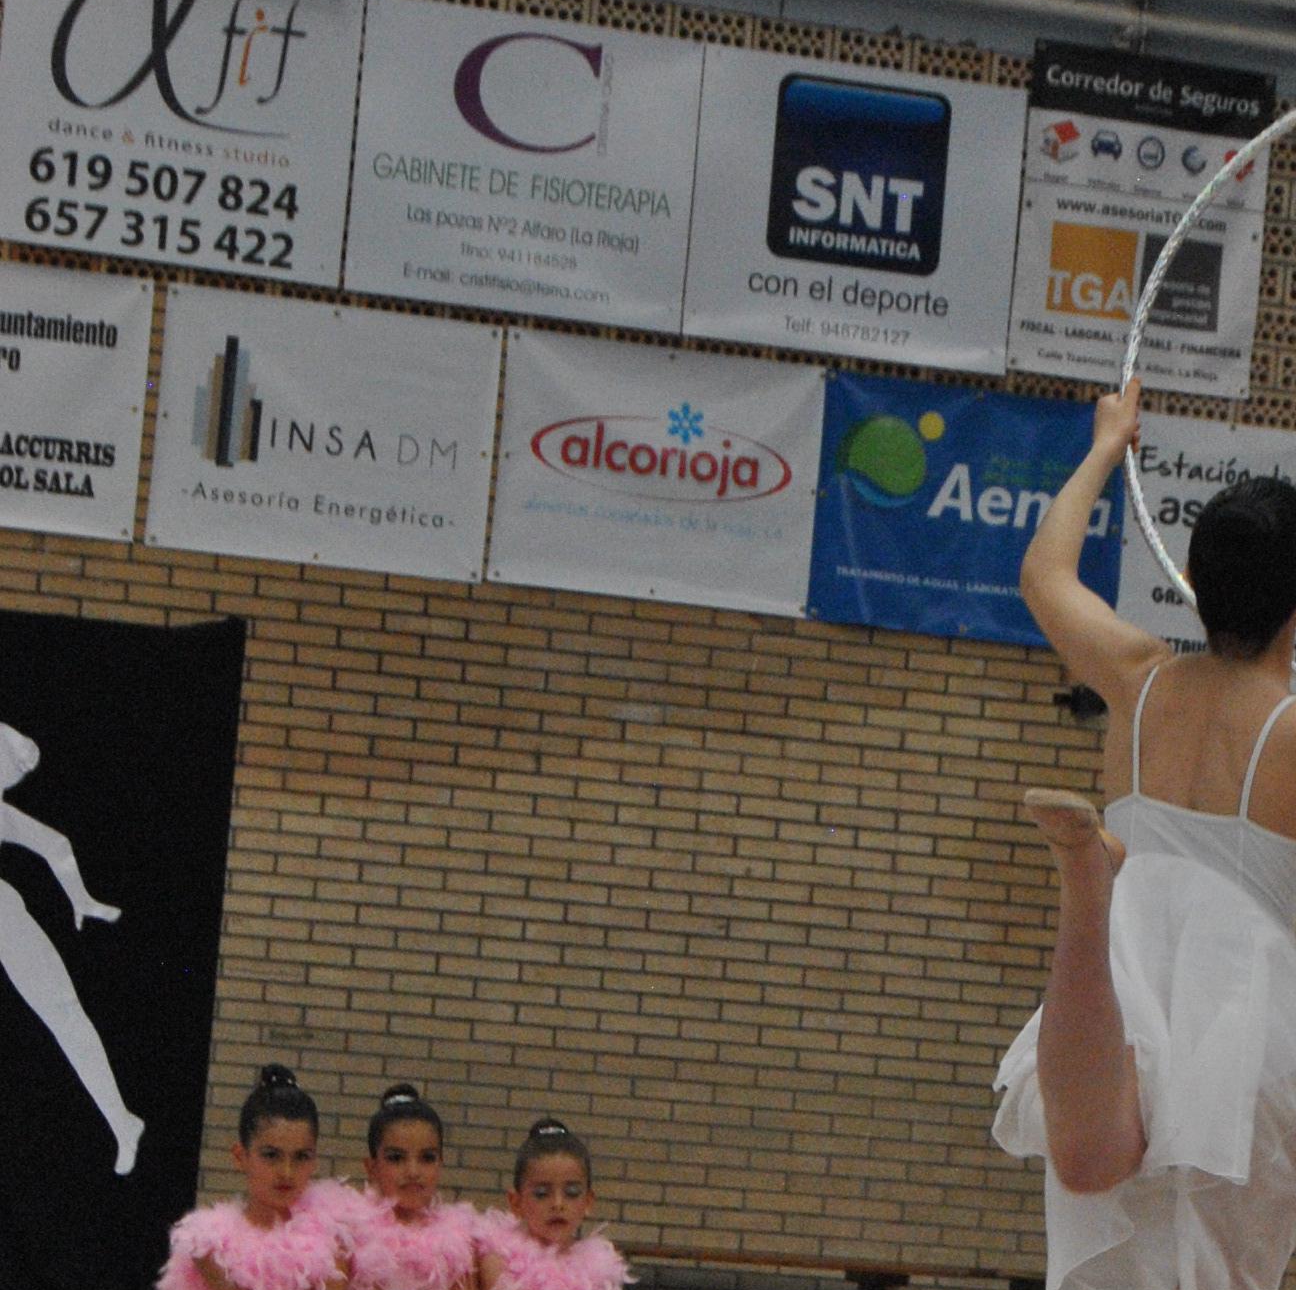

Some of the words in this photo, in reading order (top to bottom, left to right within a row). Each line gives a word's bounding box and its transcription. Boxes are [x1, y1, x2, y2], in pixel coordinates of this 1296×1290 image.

[454, 32, 602, 154] C
[1047, 63, 1144, 97] Corredor
[1150, 80, 1173, 102] de
[1180, 86, 1260, 117] Seguros
[48, 117, 113, 141] dance
[121, 130, 135, 144] &
[145, 132, 213, 157] fitness
[222, 146, 290, 169] studio
[29, 146, 113, 191] 619
[125, 160, 206, 205] 507
[218, 174, 299, 221] 824
[373, 152, 480, 193] GABINETE
[489, 169, 520, 198] DE
[531, 174, 671, 219] FISIOTERAPIA
[792, 165, 924, 235] SNT
[25, 197, 108, 240] 657
[120, 210, 202, 255] 315
[214, 224, 294, 270] 422
[789, 226, 921, 261] INFORMATICA
[749, 271, 798, 298] con
[809, 275, 832, 302] el
[843, 279, 949, 317] deporte
[1050, 269, 1134, 313] TGA
[0, 310, 118, 348] untamiento
[0, 431, 116, 468] ACCURRIS
[270, 417, 377, 462] INSA
[397, 434, 458, 470] DM
[561, 420, 760, 498] alcorioja
[0, 466, 29, 491] OL
[33, 468, 95, 499] SALA
